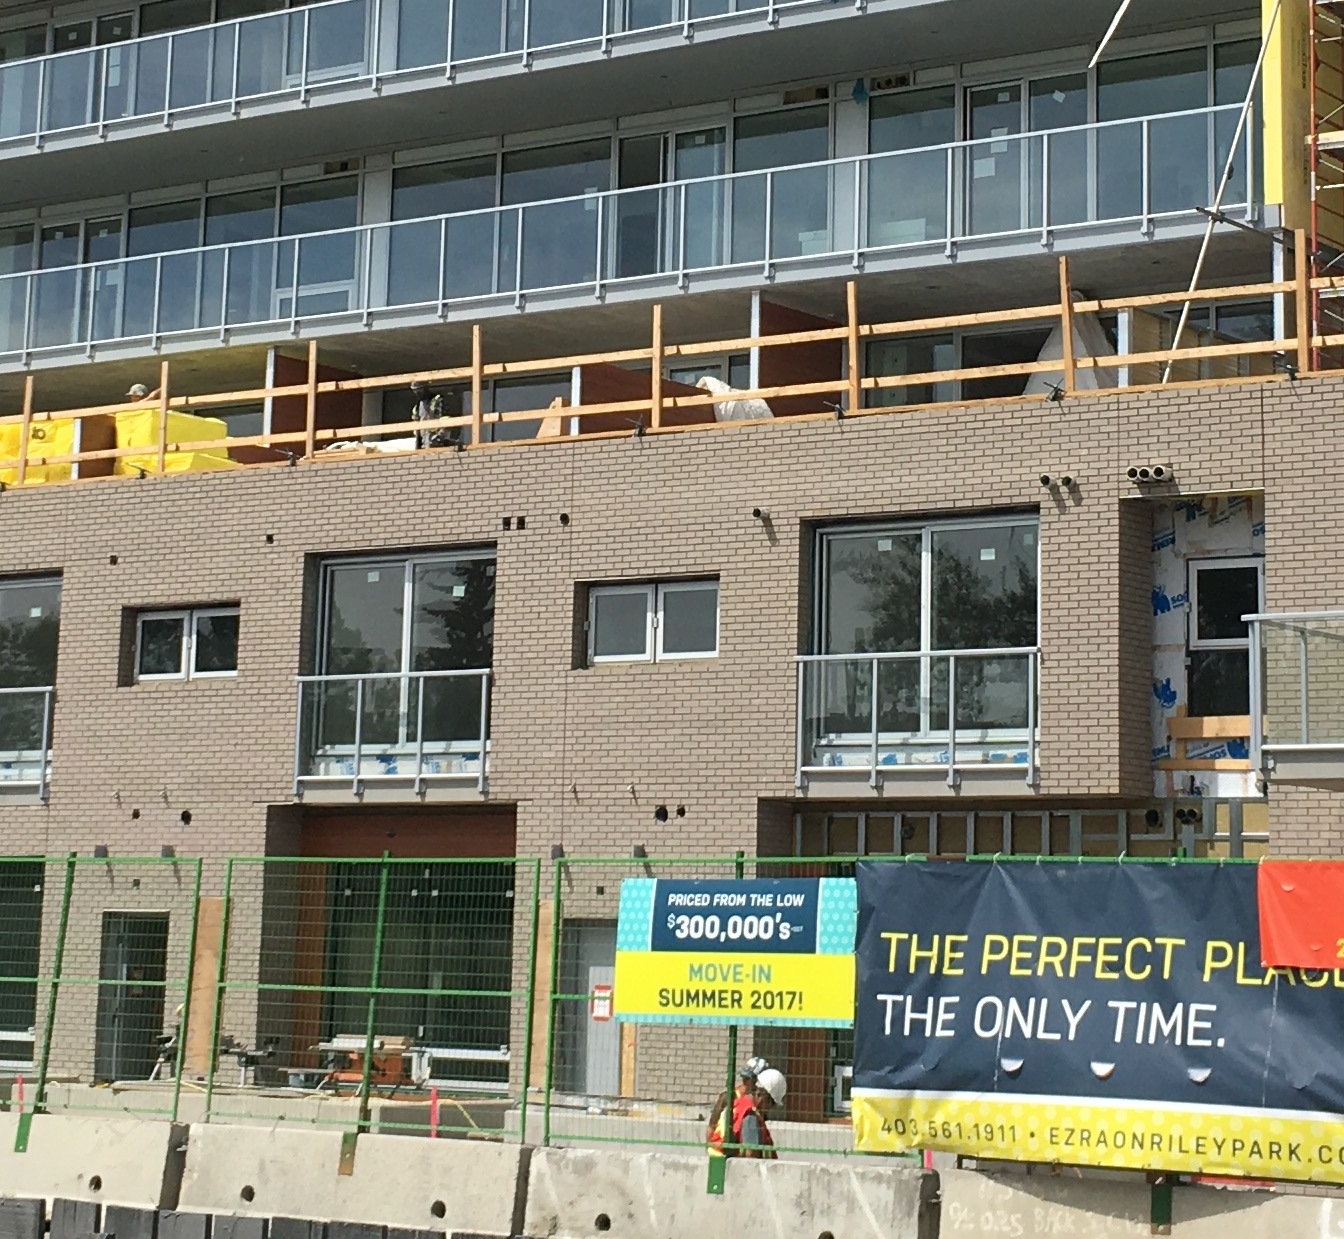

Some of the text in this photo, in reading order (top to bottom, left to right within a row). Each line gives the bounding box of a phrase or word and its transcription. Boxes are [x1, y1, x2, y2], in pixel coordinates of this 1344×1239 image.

[668, 893, 805, 907] PRICED FROM THE LOW
[667, 913, 791, 942] $300,000's
[880, 932, 969, 976] THE
[980, 933, 1186, 981] PERFECT
[688, 963, 772, 984] MOVE-IN
[658, 988, 804, 1011] SUMMER 2017!
[876, 994, 1226, 1048] THE ONLY TIME.
[880, 1116, 1018, 1144] 403.561.1911
